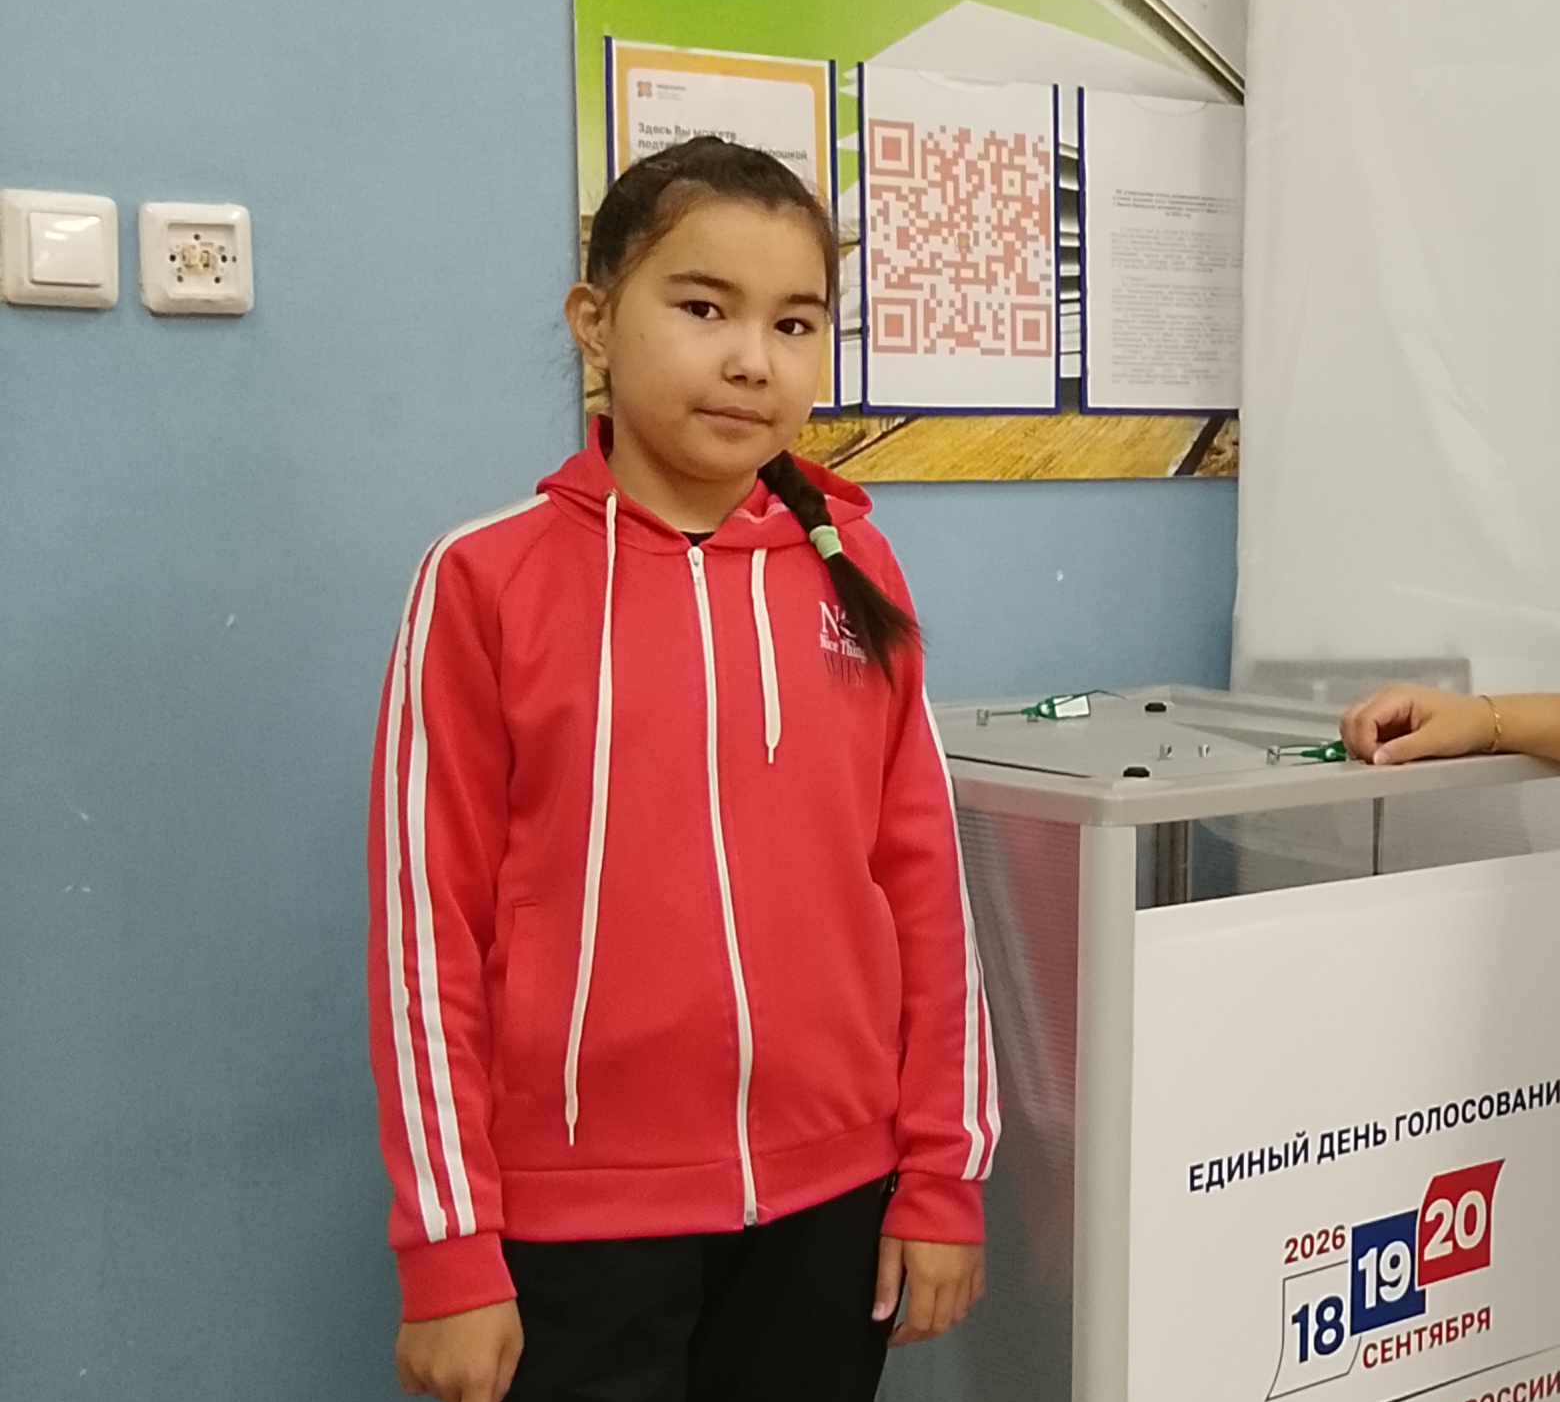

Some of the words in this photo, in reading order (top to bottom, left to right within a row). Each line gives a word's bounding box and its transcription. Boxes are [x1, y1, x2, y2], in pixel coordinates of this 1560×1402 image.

[638, 121, 671, 136] Здесь
[674, 124, 690, 136] Вы
[1188, 1131, 1310, 1193] ЕДИНЫЙ
[1316, 1121, 1387, 1165] ДЕНЬ
[1283, 1224, 1347, 1265] 2026
[1291, 1294, 1346, 1364] 18
[1357, 1239, 1411, 1310] 19
[1422, 1189, 1488, 1263] 20
[1361, 1306, 1492, 1370] СЕНТЯБРЯ
